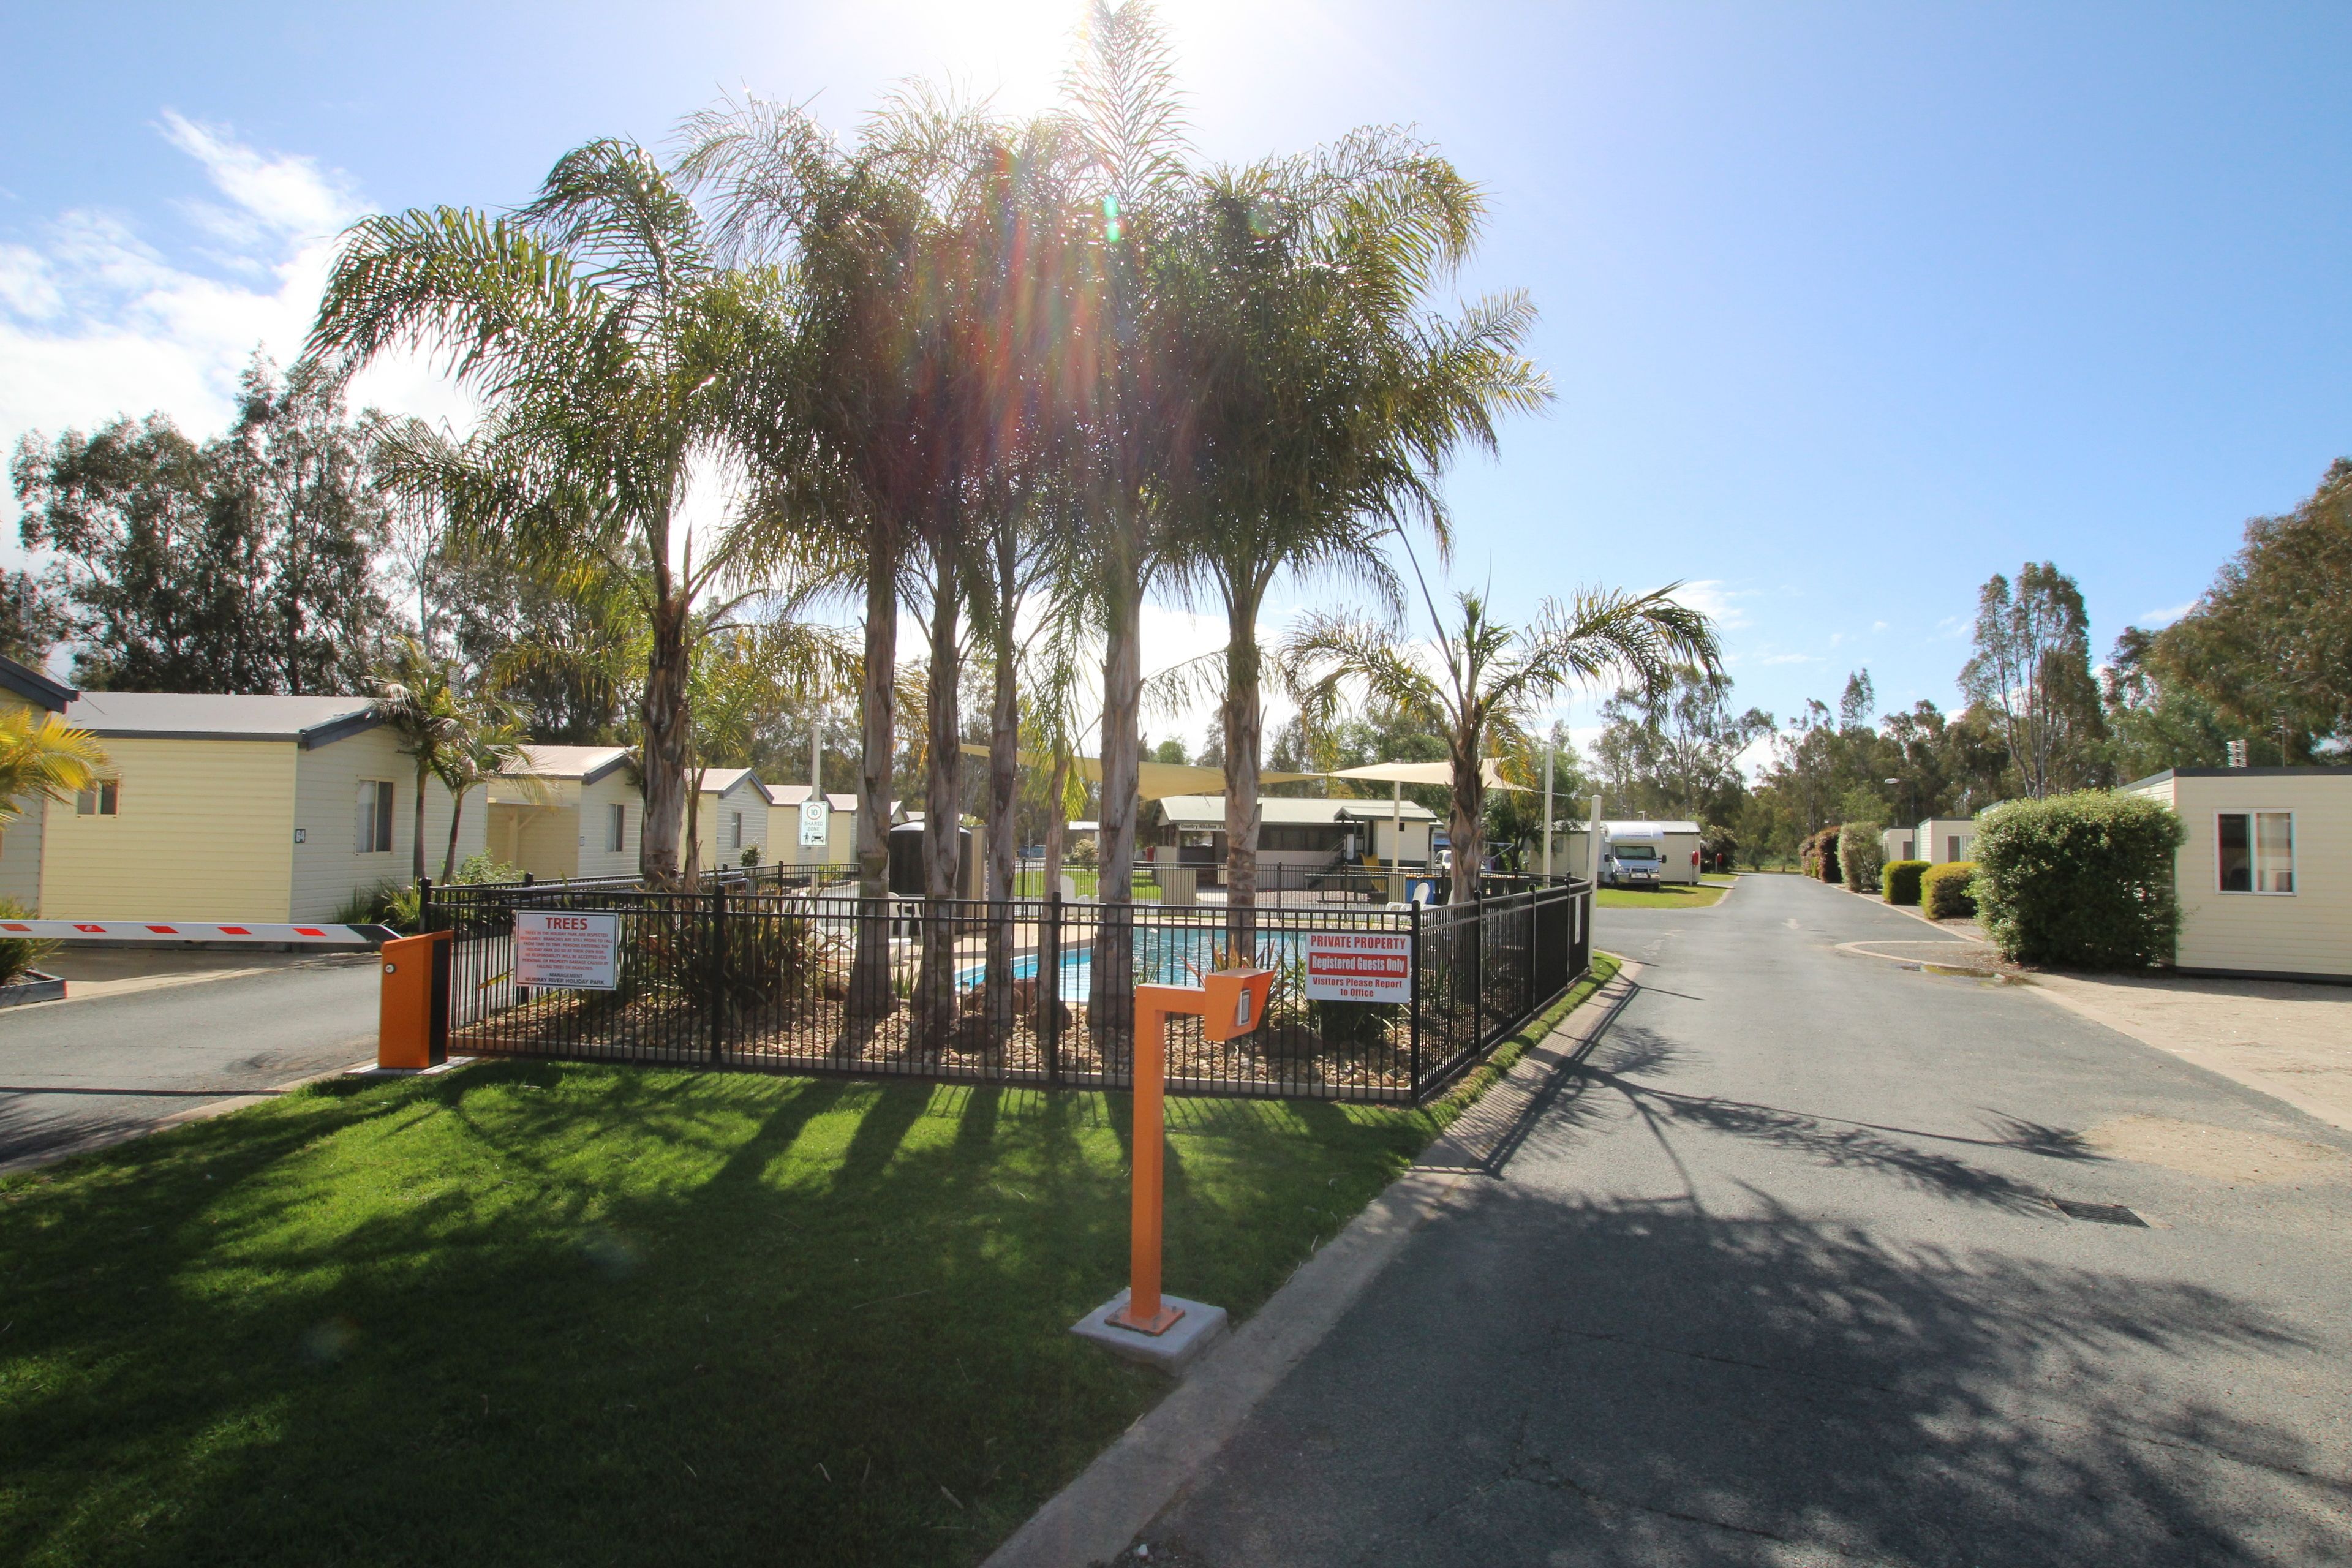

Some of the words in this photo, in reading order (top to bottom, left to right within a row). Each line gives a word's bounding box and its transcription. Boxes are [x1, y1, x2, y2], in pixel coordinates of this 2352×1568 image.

[546, 917, 587, 930] TREES
[1311, 935, 1351, 948] PRIVATE
[1354, 937, 1406, 949] PROPERTY
[1312, 956, 1355, 970] Registered
[1357, 957, 1385, 971] Guests
[1387, 958, 1404, 973] Only
[1313, 977, 1343, 986] Visitors
[1346, 978, 1373, 987] Please
[1375, 979, 1402, 989] Report
